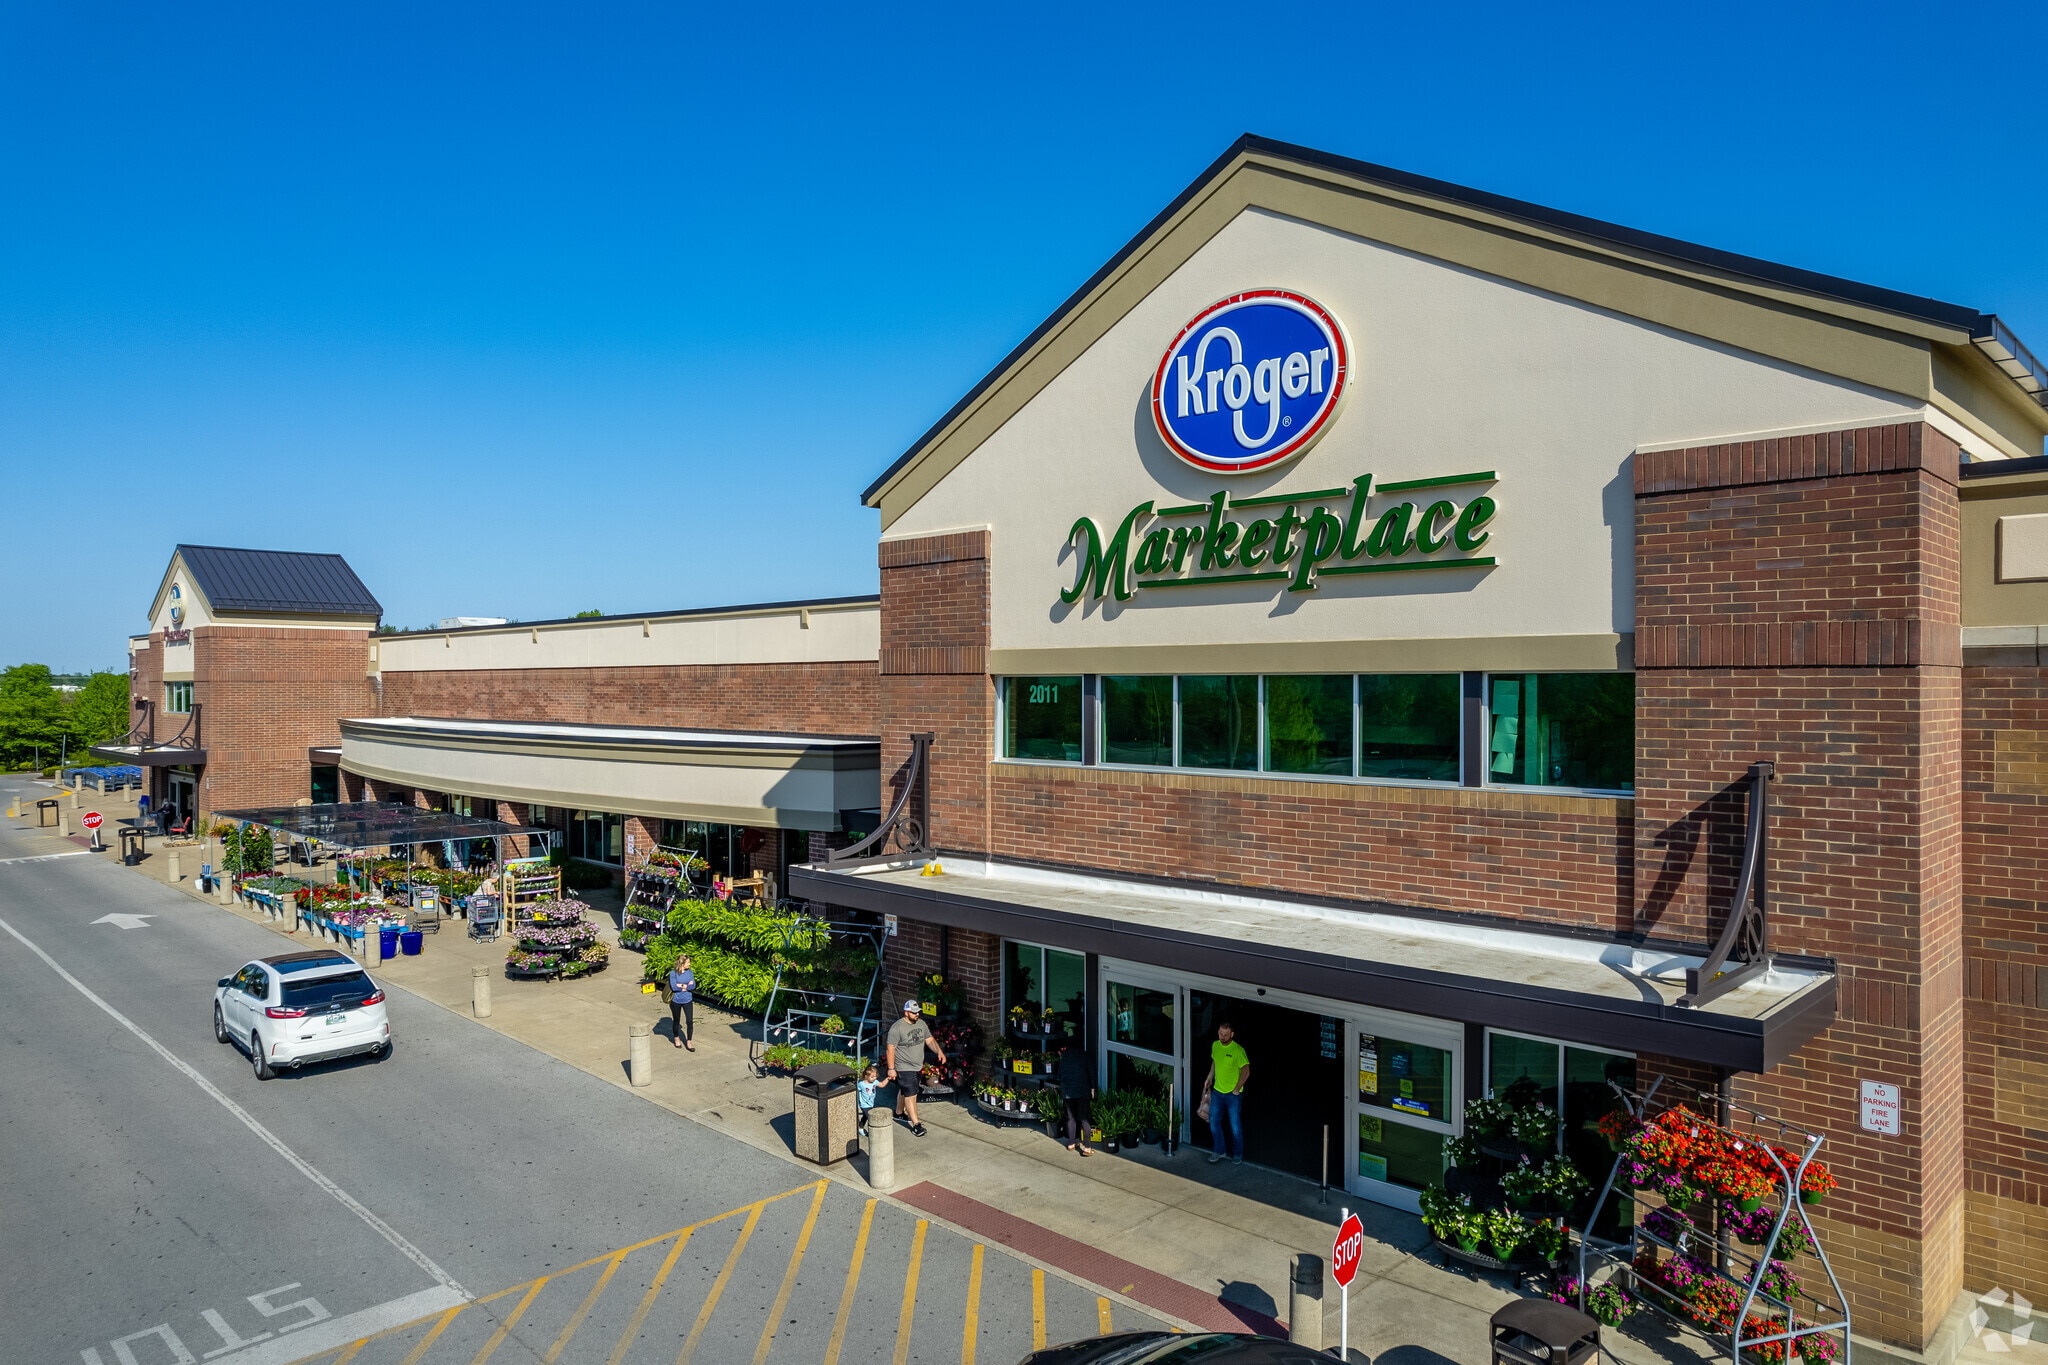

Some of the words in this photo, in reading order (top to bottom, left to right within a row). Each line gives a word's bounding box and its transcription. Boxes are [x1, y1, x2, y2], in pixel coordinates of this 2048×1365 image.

[1177, 327, 1328, 449] Kroger
[1060, 473, 1498, 604] Marketplace
[1029, 684, 1058, 704] 2011
[83, 815, 102, 825] STOP
[1874, 1088, 1886, 1097] NO
[1863, 1096, 1897, 1109] PARKING
[1871, 1108, 1889, 1118] FIRE
[1869, 1118, 1890, 1128] LANE
[1334, 1231, 1361, 1271] STOP
[79, 1281, 333, 1365] STO
